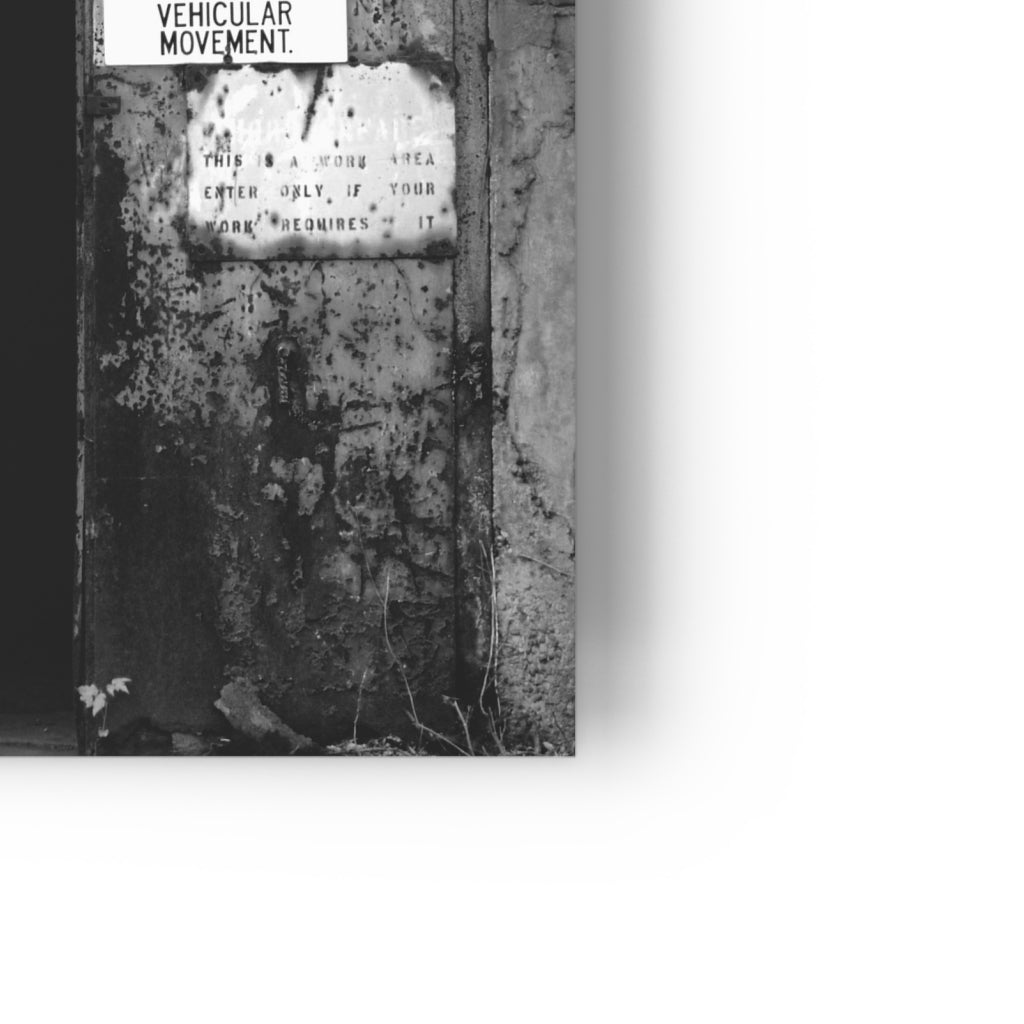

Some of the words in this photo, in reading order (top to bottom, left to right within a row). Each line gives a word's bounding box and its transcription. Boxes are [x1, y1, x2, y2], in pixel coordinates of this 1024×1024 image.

[156, 0, 293, 29] VEHICULAR
[159, 28, 294, 57] MOVEMENT.
[203, 153, 243, 168] THIS
[289, 154, 299, 168] A
[314, 153, 367, 170] WORK
[389, 151, 436, 167] AREA
[203, 184, 259, 200] ENTER
[280, 183, 324, 199] ONLY
[347, 183, 363, 198] IF
[389, 181, 436, 196] YOUR
[204, 218, 255, 234] WORK
[280, 216, 369, 233] REQUIRES
[418, 214, 436, 230] IT
